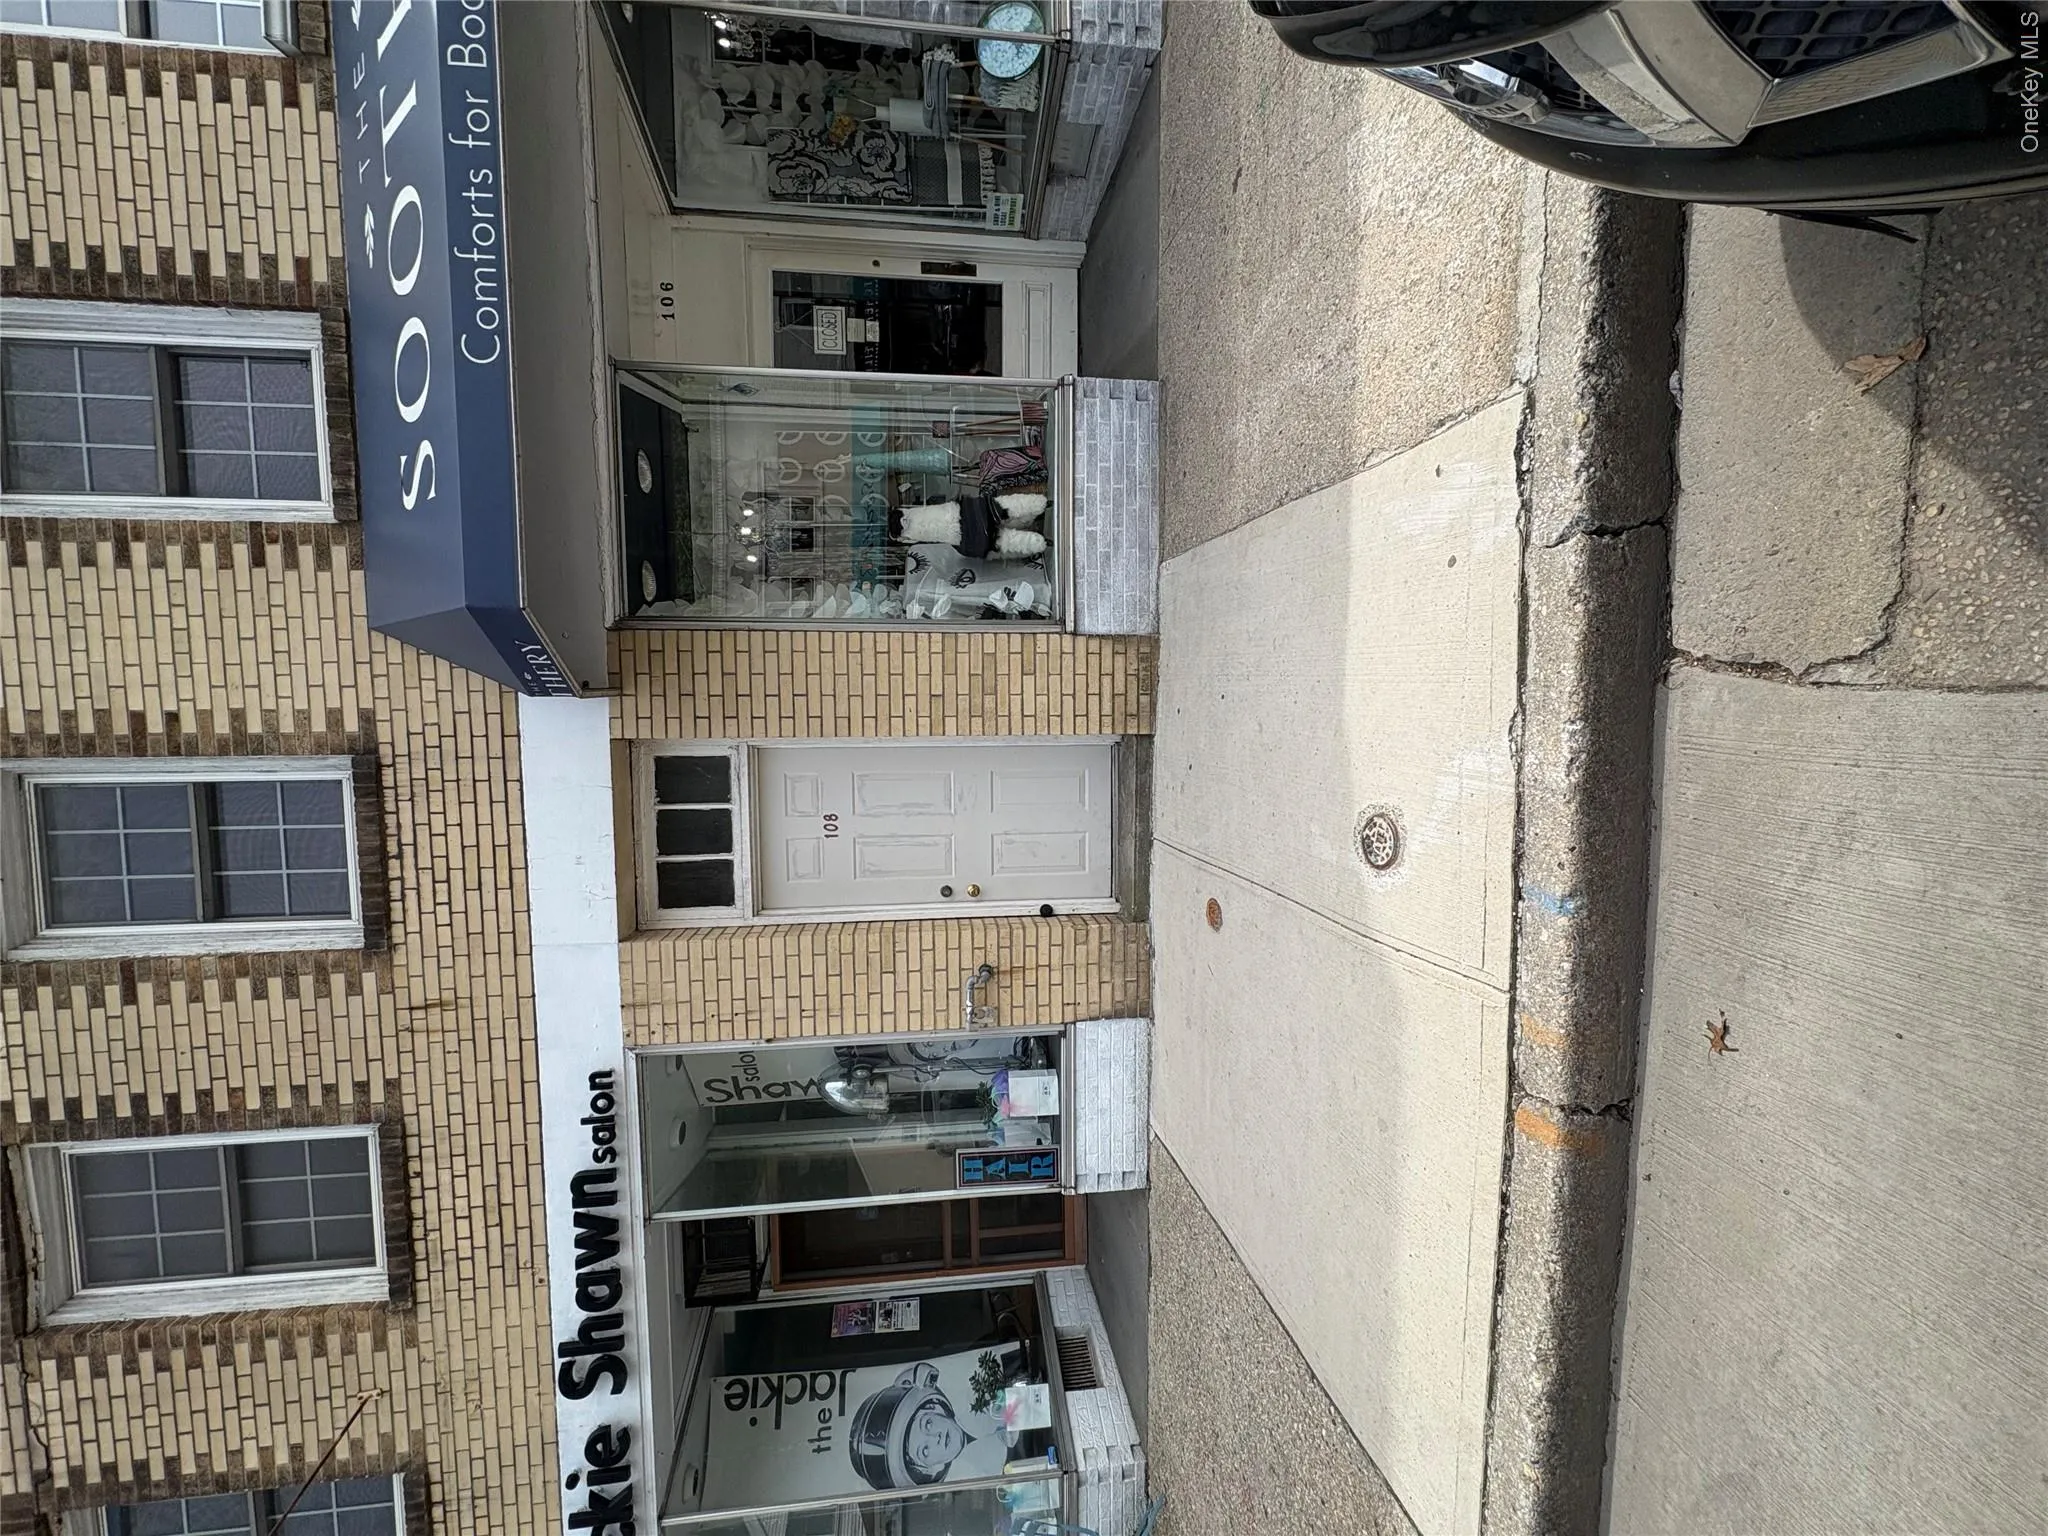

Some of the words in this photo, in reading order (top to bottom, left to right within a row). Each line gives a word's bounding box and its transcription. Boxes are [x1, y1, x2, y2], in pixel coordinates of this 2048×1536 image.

[353, 52, 371, 184] THE
[448, 89, 492, 149] for
[453, 168, 501, 364] Comforts
[659, 281, 675, 321] 106
[821, 311, 838, 349] CLOSED
[823, 813, 839, 839] 108
[580, 1069, 618, 1164] salon
[964, 1153, 1054, 1182] HAIR
[558, 1167, 628, 1400] Shawn
[724, 1368, 857, 1430] Jackie
[808, 1408, 832, 1454] the
